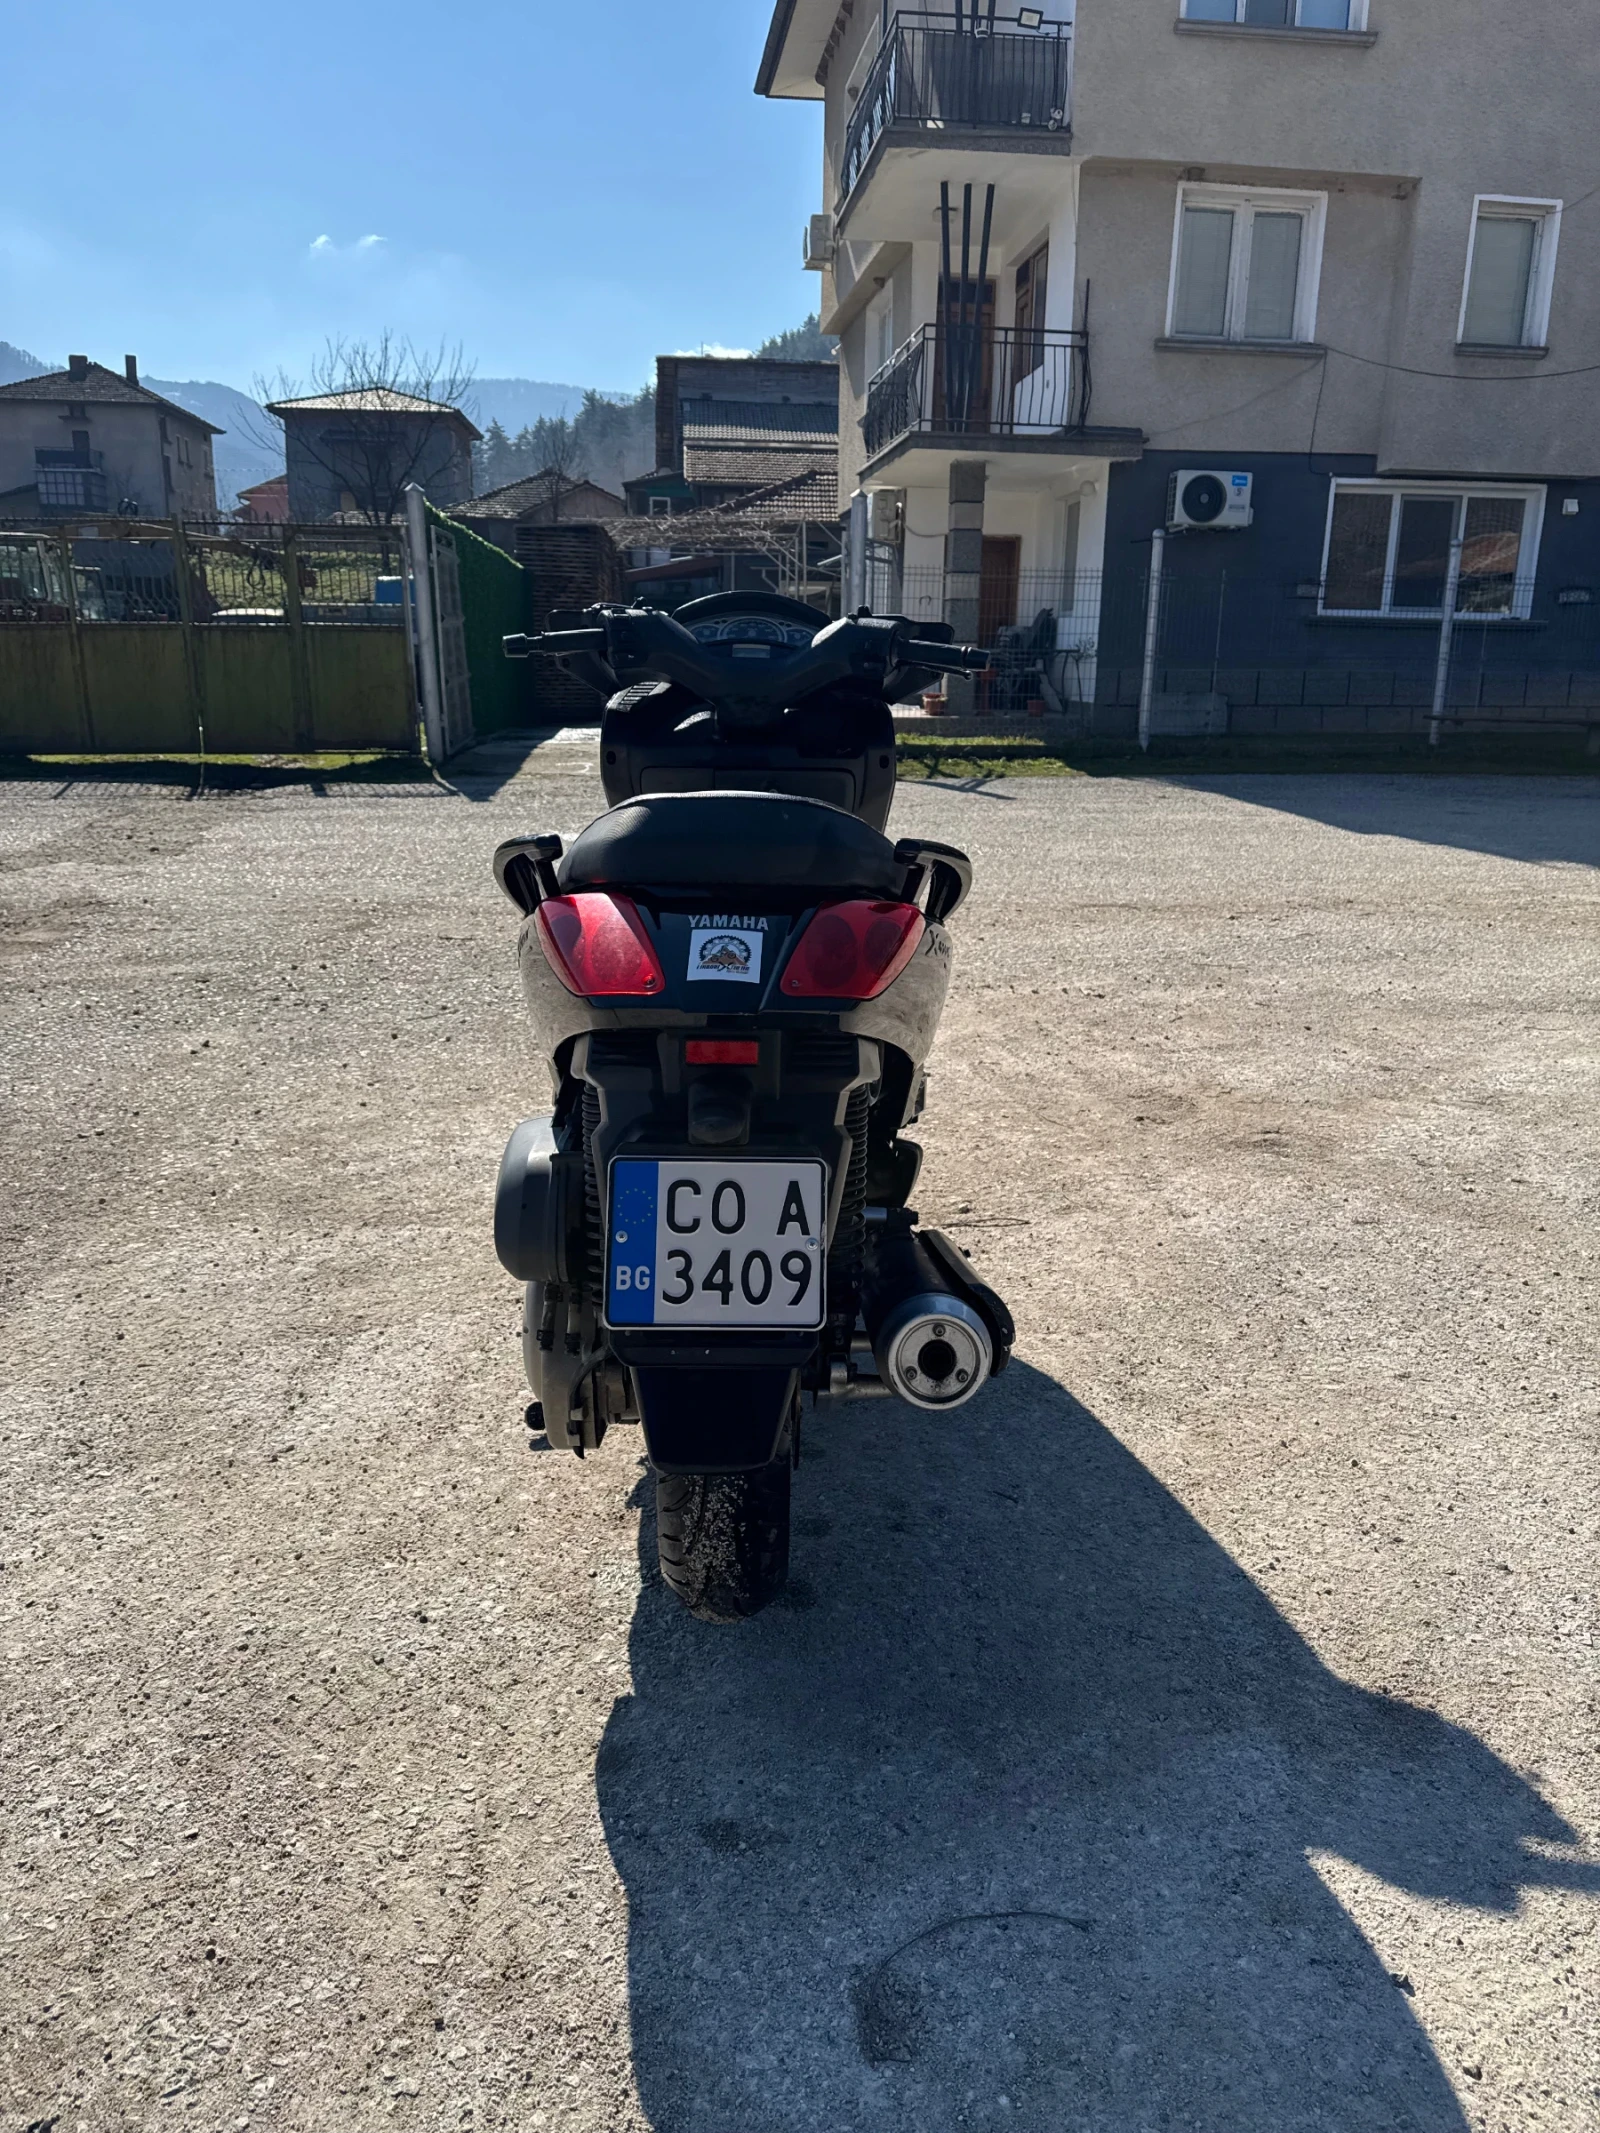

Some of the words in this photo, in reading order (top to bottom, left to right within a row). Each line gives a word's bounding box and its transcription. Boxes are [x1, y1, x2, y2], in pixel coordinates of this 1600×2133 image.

[688, 915, 769, 930] YAMAHA
[666, 1179, 746, 1235] CO
[776, 1180, 811, 1236] A
[615, 1265, 651, 1291] BG
[662, 1249, 812, 1306] 3409
